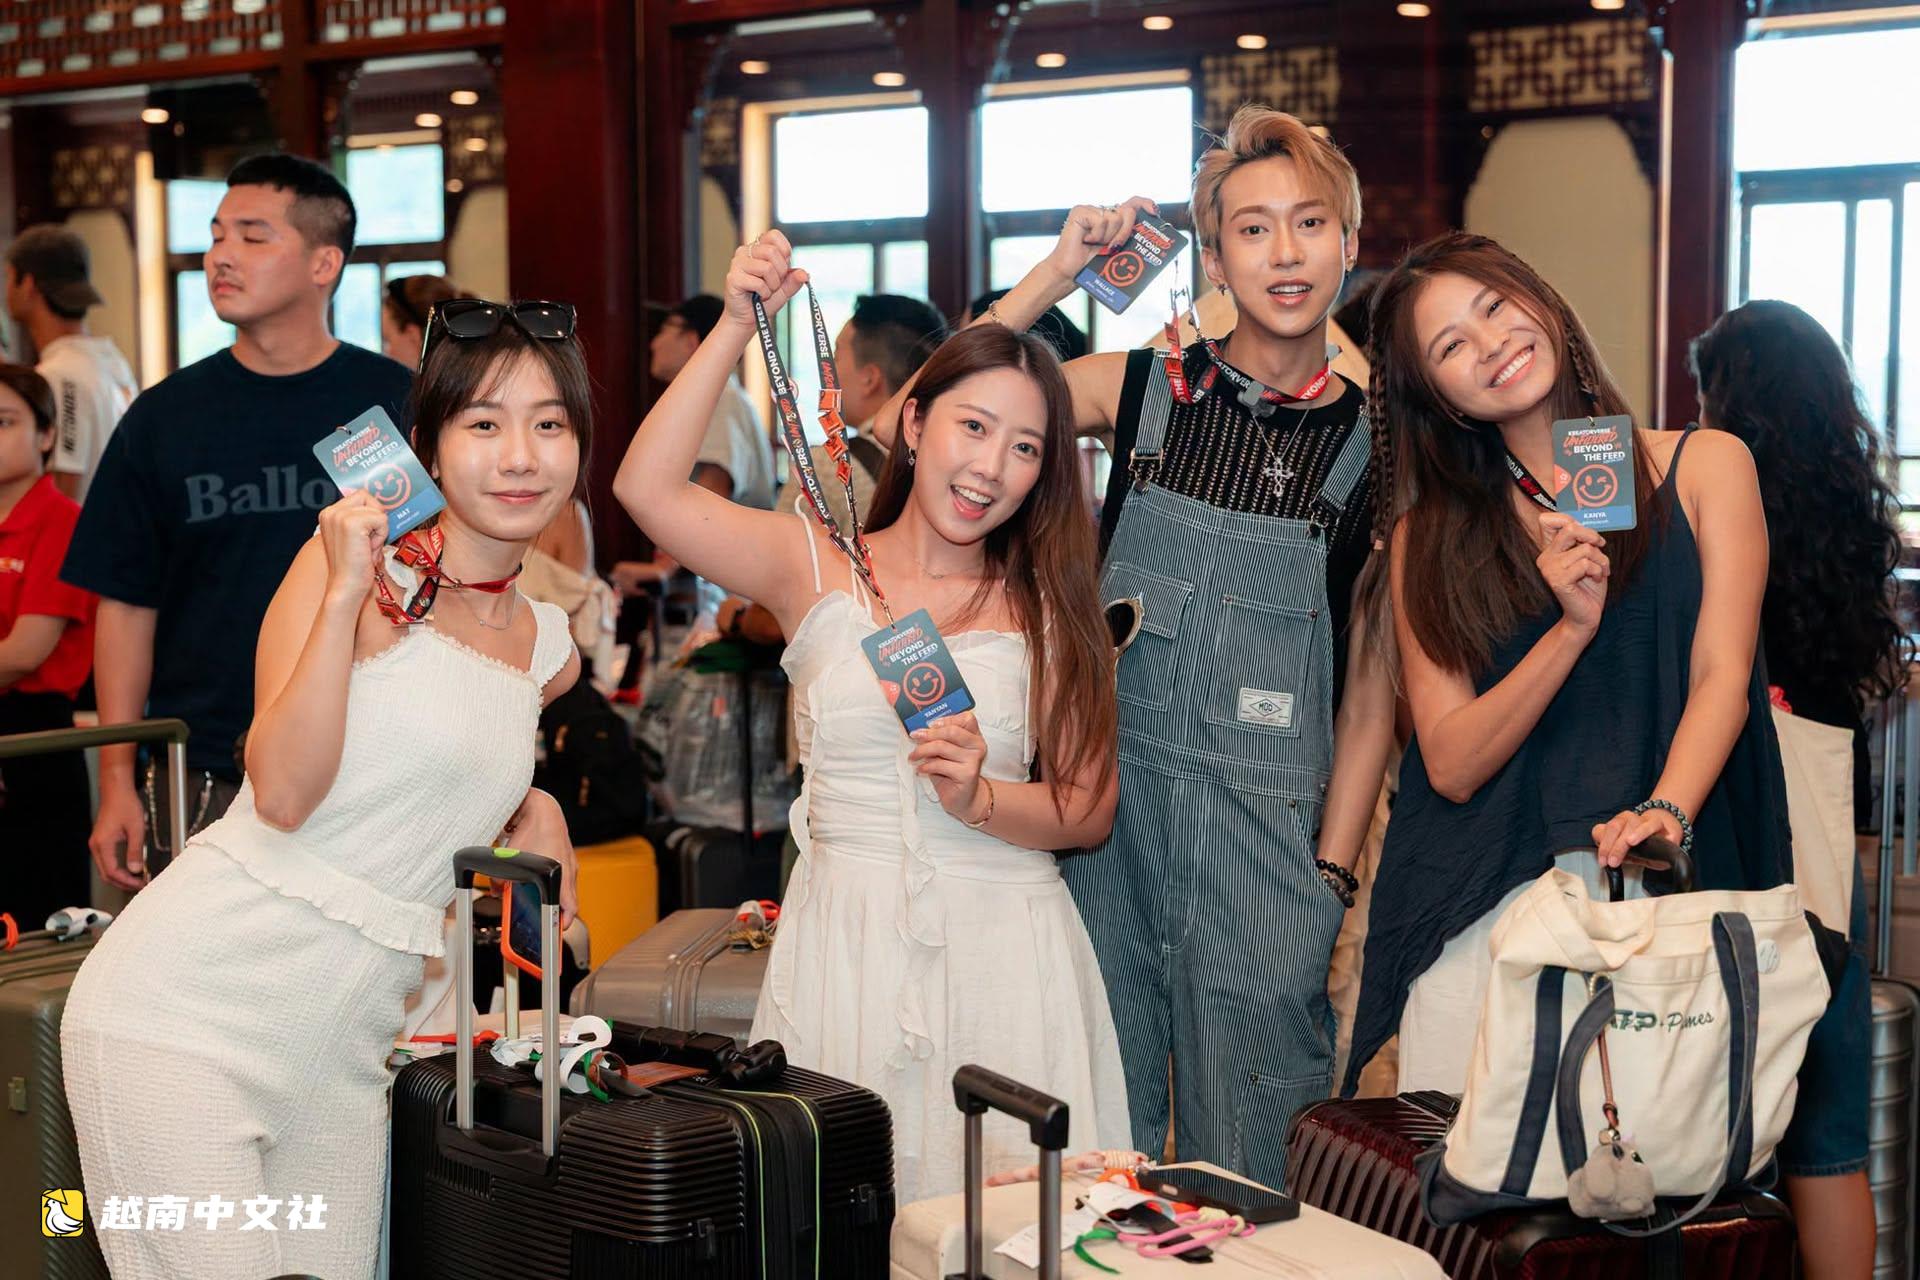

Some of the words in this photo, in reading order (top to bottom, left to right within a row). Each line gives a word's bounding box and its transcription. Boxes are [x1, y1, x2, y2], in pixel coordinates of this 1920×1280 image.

[1134, 232, 1161, 255] BEYOND
[1135, 243, 1149, 256] THE
[755, 302, 767, 328] FEED
[761, 328, 773, 351] THE
[767, 350, 787, 395] BEYOND
[346, 439, 383, 468] BEYOND
[360, 453, 379, 469] THE
[375, 440, 399, 460] FEED
[1573, 443, 1613, 454] BEYOND
[1583, 453, 1602, 462] THE
[1602, 451, 1626, 461] FEED
[890, 640, 924, 663] BEYOND
[901, 652, 919, 666] THE
[917, 642, 938, 658] FEED
